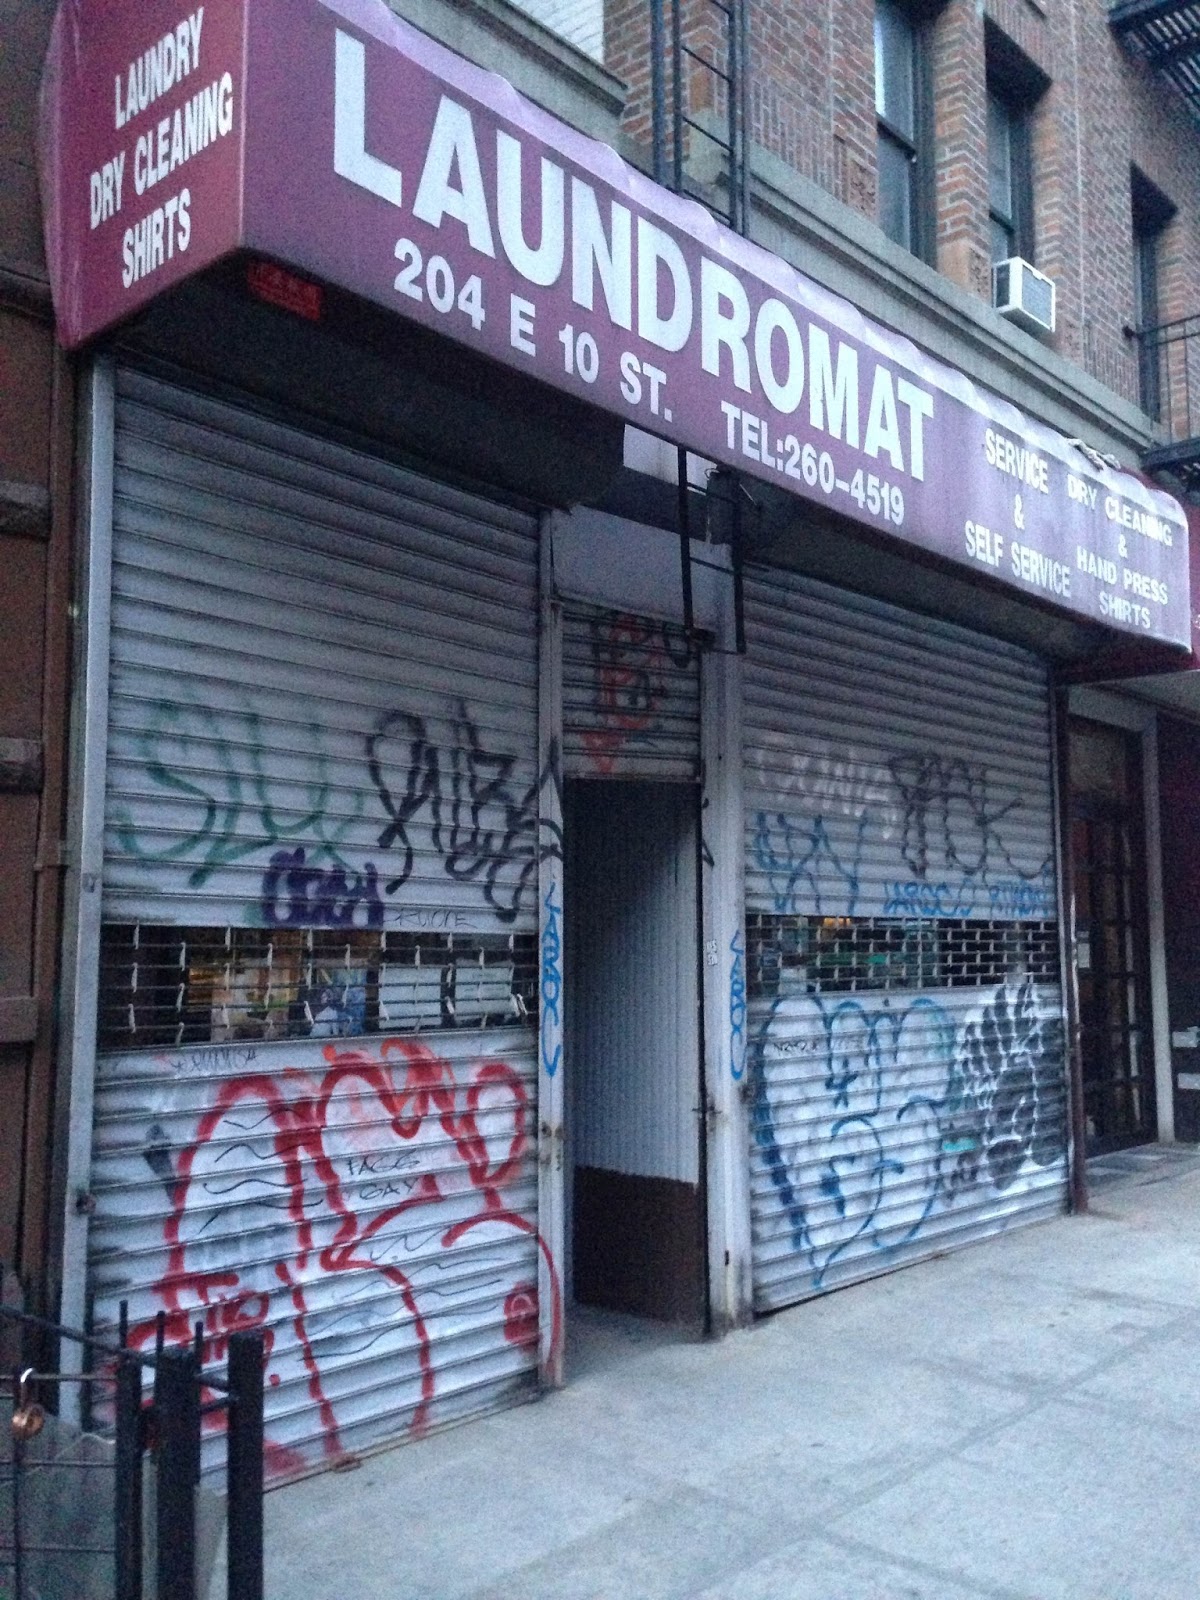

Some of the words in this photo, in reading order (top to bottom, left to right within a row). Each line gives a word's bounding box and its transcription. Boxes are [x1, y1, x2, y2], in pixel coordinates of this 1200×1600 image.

[114, 7, 202, 129] LAUNDRY
[90, 151, 126, 229] DRY
[134, 72, 233, 196] CLEANING
[122, 188, 191, 289] SHIRTS
[333, 28, 934, 482] LAUNDROMAT
[394, 237, 486, 330] 204
[510, 293, 536, 357] E
[558, 323, 599, 384] 10
[620, 351, 673, 422] ST.
[985, 428, 1049, 494] SERVICE
[1013, 494, 1025, 530] &
[1067, 473, 1097, 511] DRY
[1104, 495, 1173, 547] CLEANING
[1117, 533, 1128, 559] &
[964, 520, 1003, 568] SELF
[1011, 541, 1071, 598] SERVICE
[1076, 545, 1117, 585] HAND
[1123, 568, 1168, 605] PRESS
[1099, 591, 1151, 629] SHIRTS
